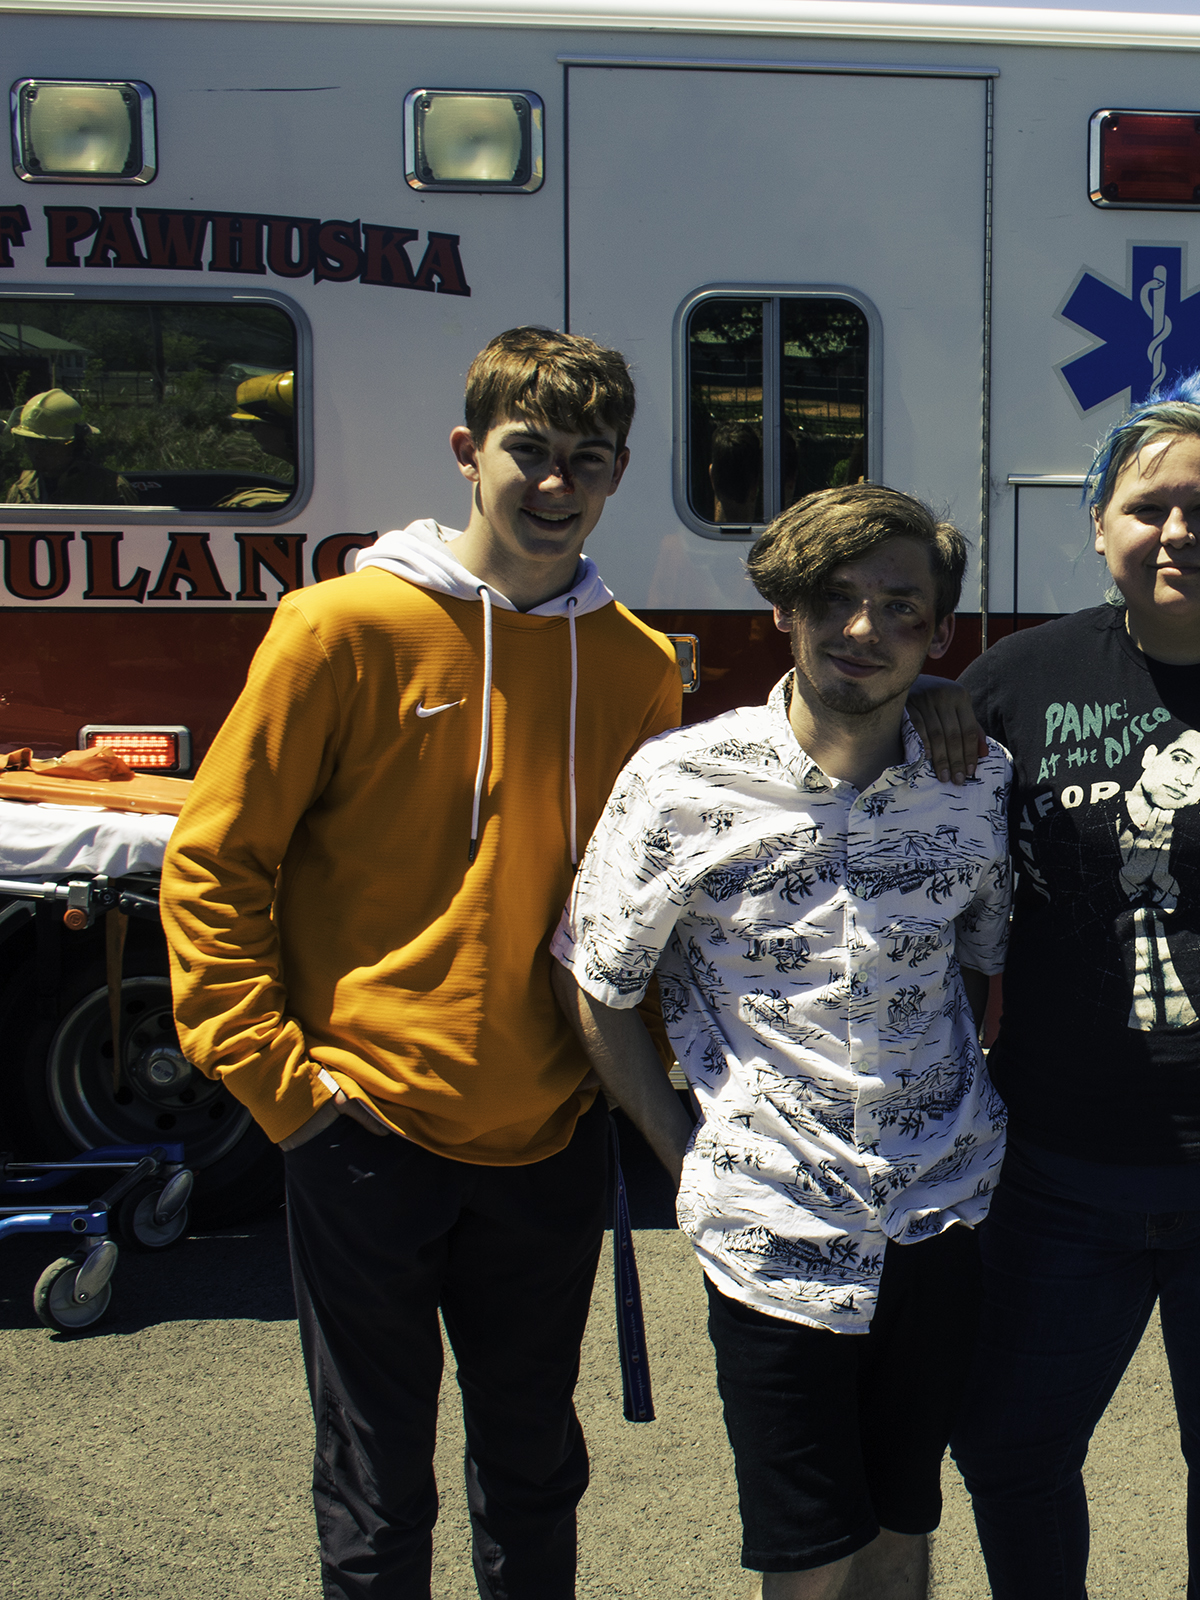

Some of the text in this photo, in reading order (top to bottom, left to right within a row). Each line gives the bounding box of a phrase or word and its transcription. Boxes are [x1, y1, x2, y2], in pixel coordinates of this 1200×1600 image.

[43, 205, 471, 297] PAWHUSKA
[1037, 752, 1061, 784] AT
[1104, 706, 1171, 768] DISCO
[1045, 698, 1129, 748] PANIC!
